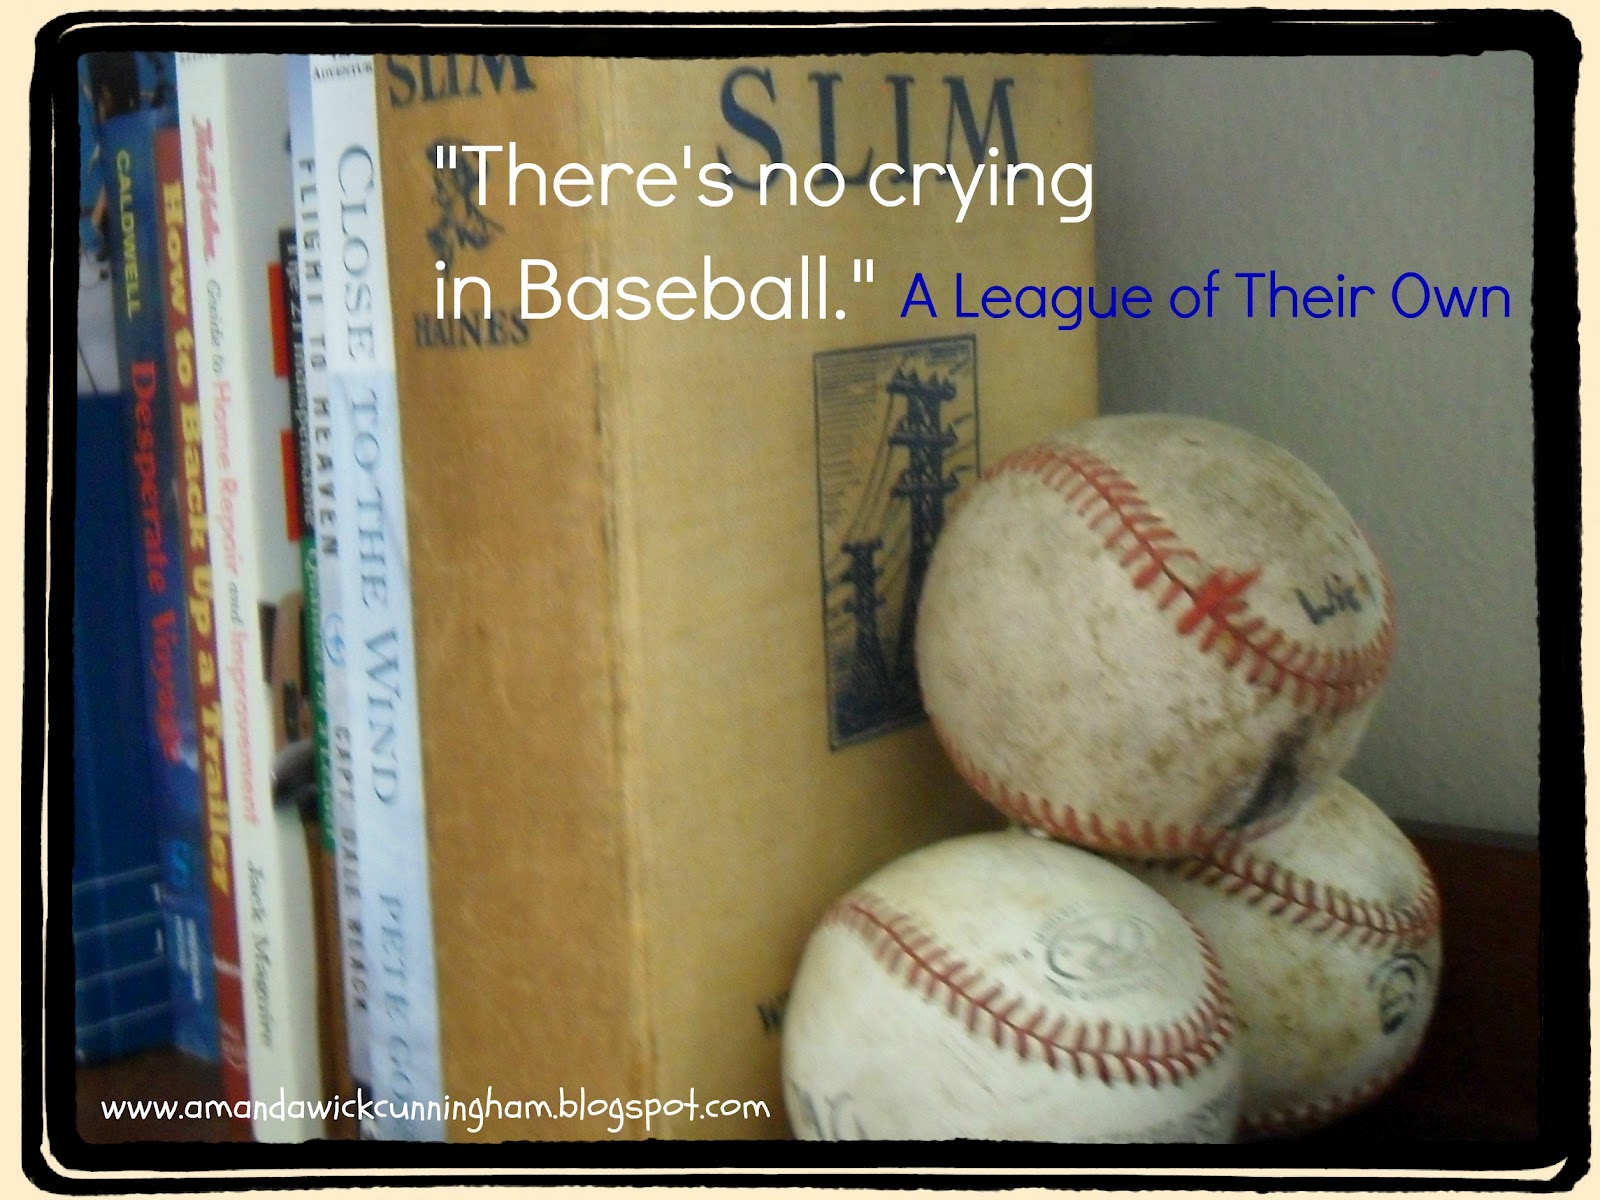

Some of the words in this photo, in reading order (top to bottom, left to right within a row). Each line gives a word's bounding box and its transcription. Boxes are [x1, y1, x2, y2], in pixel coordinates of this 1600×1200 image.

[384, 54, 538, 109] SLIM
[715, 65, 1031, 193] SLIM
[115, 149, 142, 322] CALDWELL
[162, 181, 188, 317] How
[298, 159, 324, 304] FLIGHT
[337, 143, 375, 361] CLOSE
[173, 326, 197, 390] to
[206, 277, 224, 348] Guide
[309, 334, 327, 370] TO
[414, 307, 532, 349] HAINES
[131, 359, 169, 594] Desperate
[180, 402, 207, 553] Back
[211, 379, 231, 470] Home
[312, 396, 339, 557] HEAVEN
[349, 389, 381, 473] TO
[215, 476, 244, 579] Repair
[355, 486, 389, 610] THE
[188, 563, 214, 638] Up
[228, 581, 248, 627] and
[197, 650, 216, 686] a
[364, 629, 402, 804] WIND
[229, 629, 260, 826] Improvement
[201, 700, 231, 896] Trailer
[247, 859, 267, 924] Jack
[338, 826, 362, 900] DALE
[253, 939, 277, 1049] Maguire
[347, 918, 369, 1015] BLACK
[378, 892, 410, 1022] PETE
